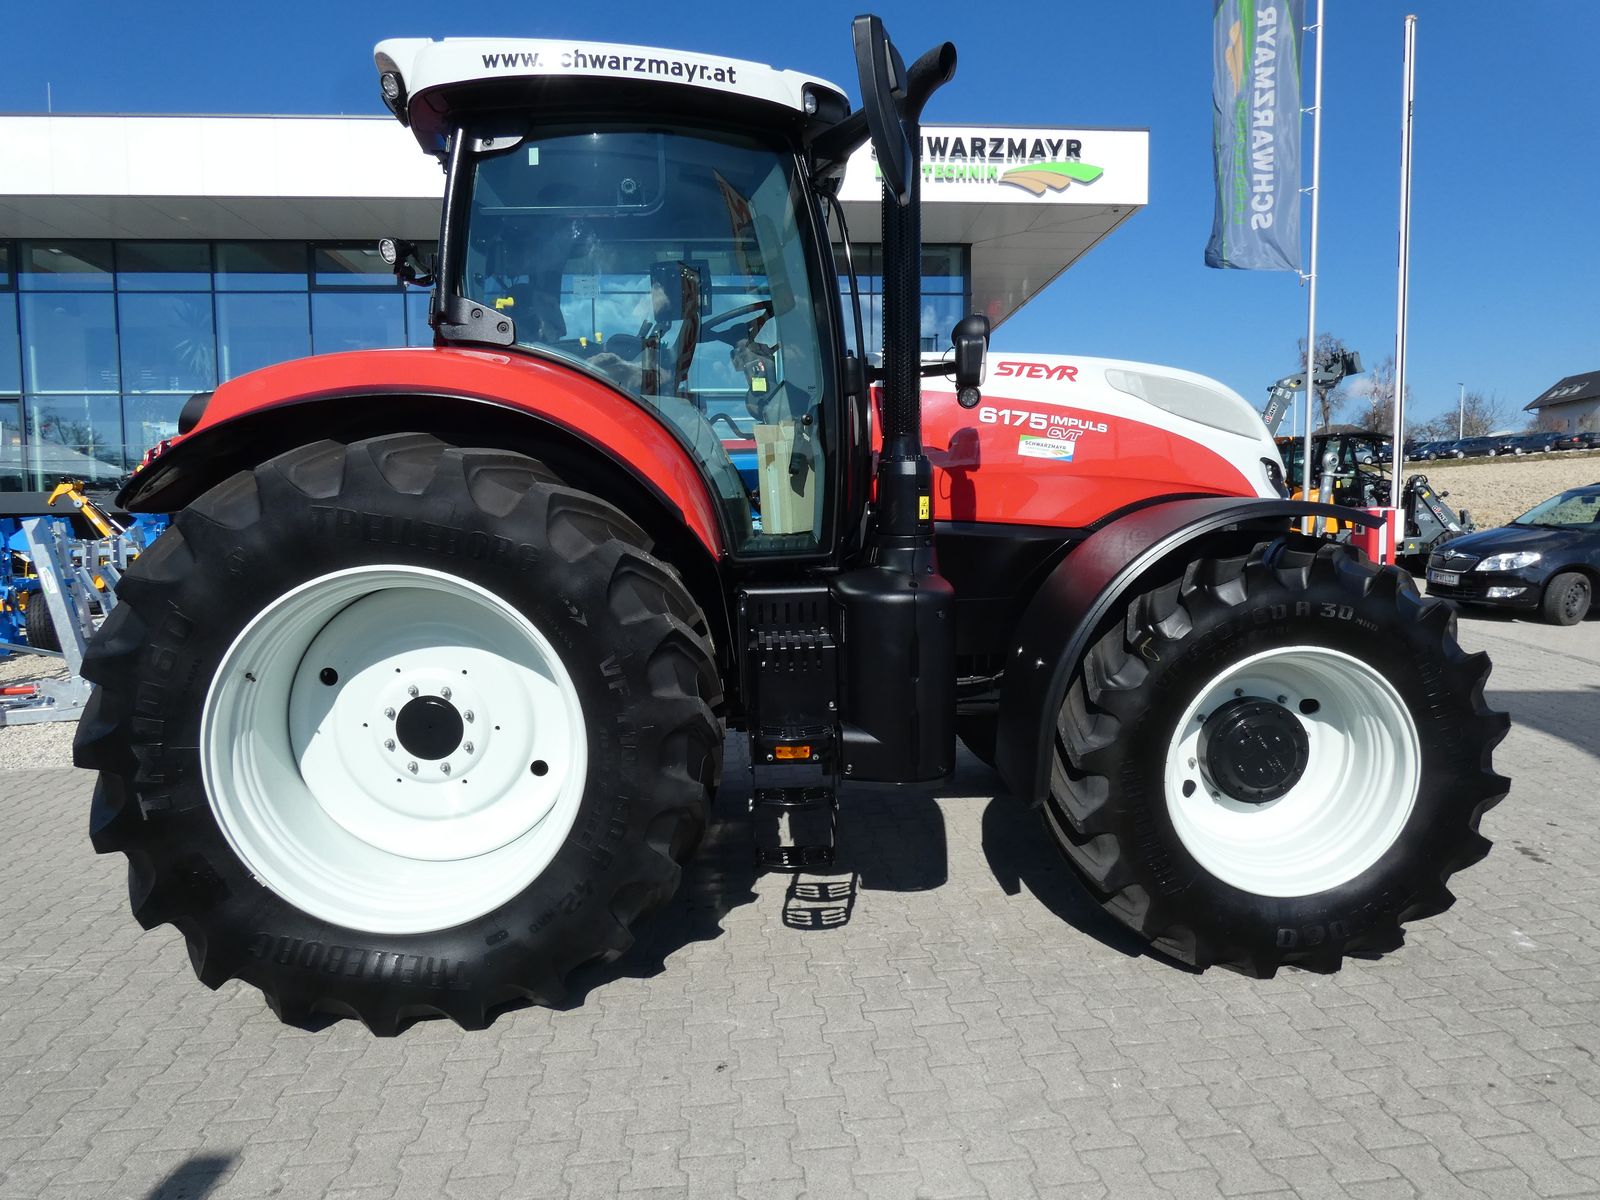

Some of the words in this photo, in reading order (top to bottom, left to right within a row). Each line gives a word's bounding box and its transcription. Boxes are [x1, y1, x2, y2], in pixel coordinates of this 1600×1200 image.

[482, 49, 737, 84] www.chwarzmayr.at
[994, 361, 1078, 383] STEYR
[979, 407, 1048, 431] 6175
[1050, 415, 1108, 433] IMPULS
[1047, 427, 1083, 442] CVT
[1025, 440, 1067, 451] SCHWARZMAYR
[1320, 601, 1354, 620] 30
